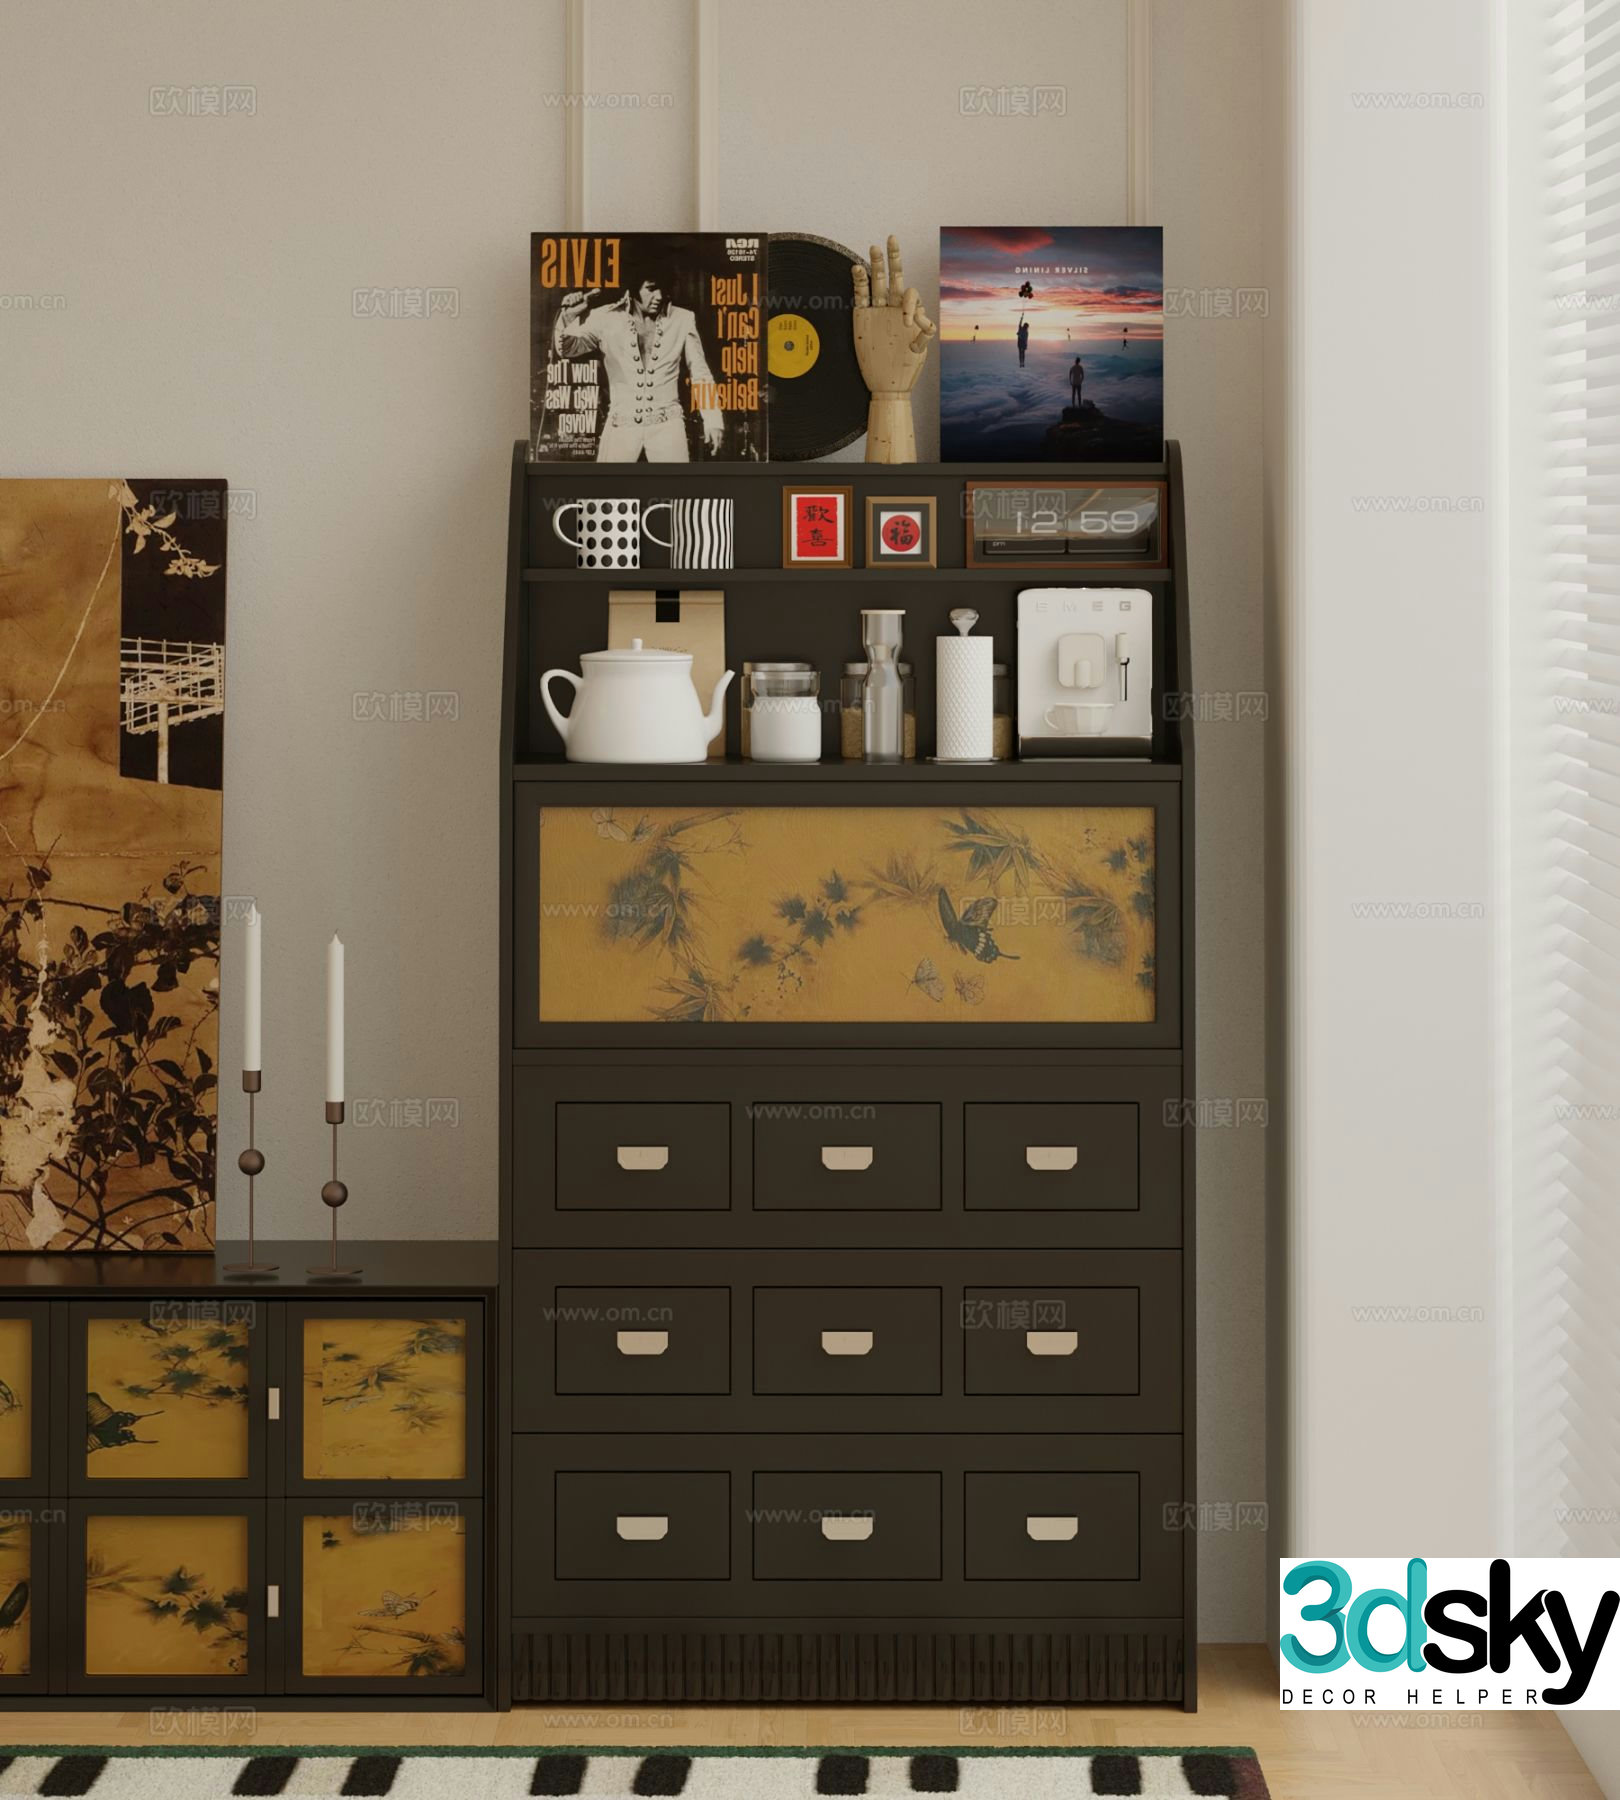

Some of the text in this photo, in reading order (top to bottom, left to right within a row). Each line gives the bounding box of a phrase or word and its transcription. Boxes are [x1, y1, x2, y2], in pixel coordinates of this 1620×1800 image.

[889, 519, 914, 546] 福
[1016, 510, 1139, 534] 12 59
